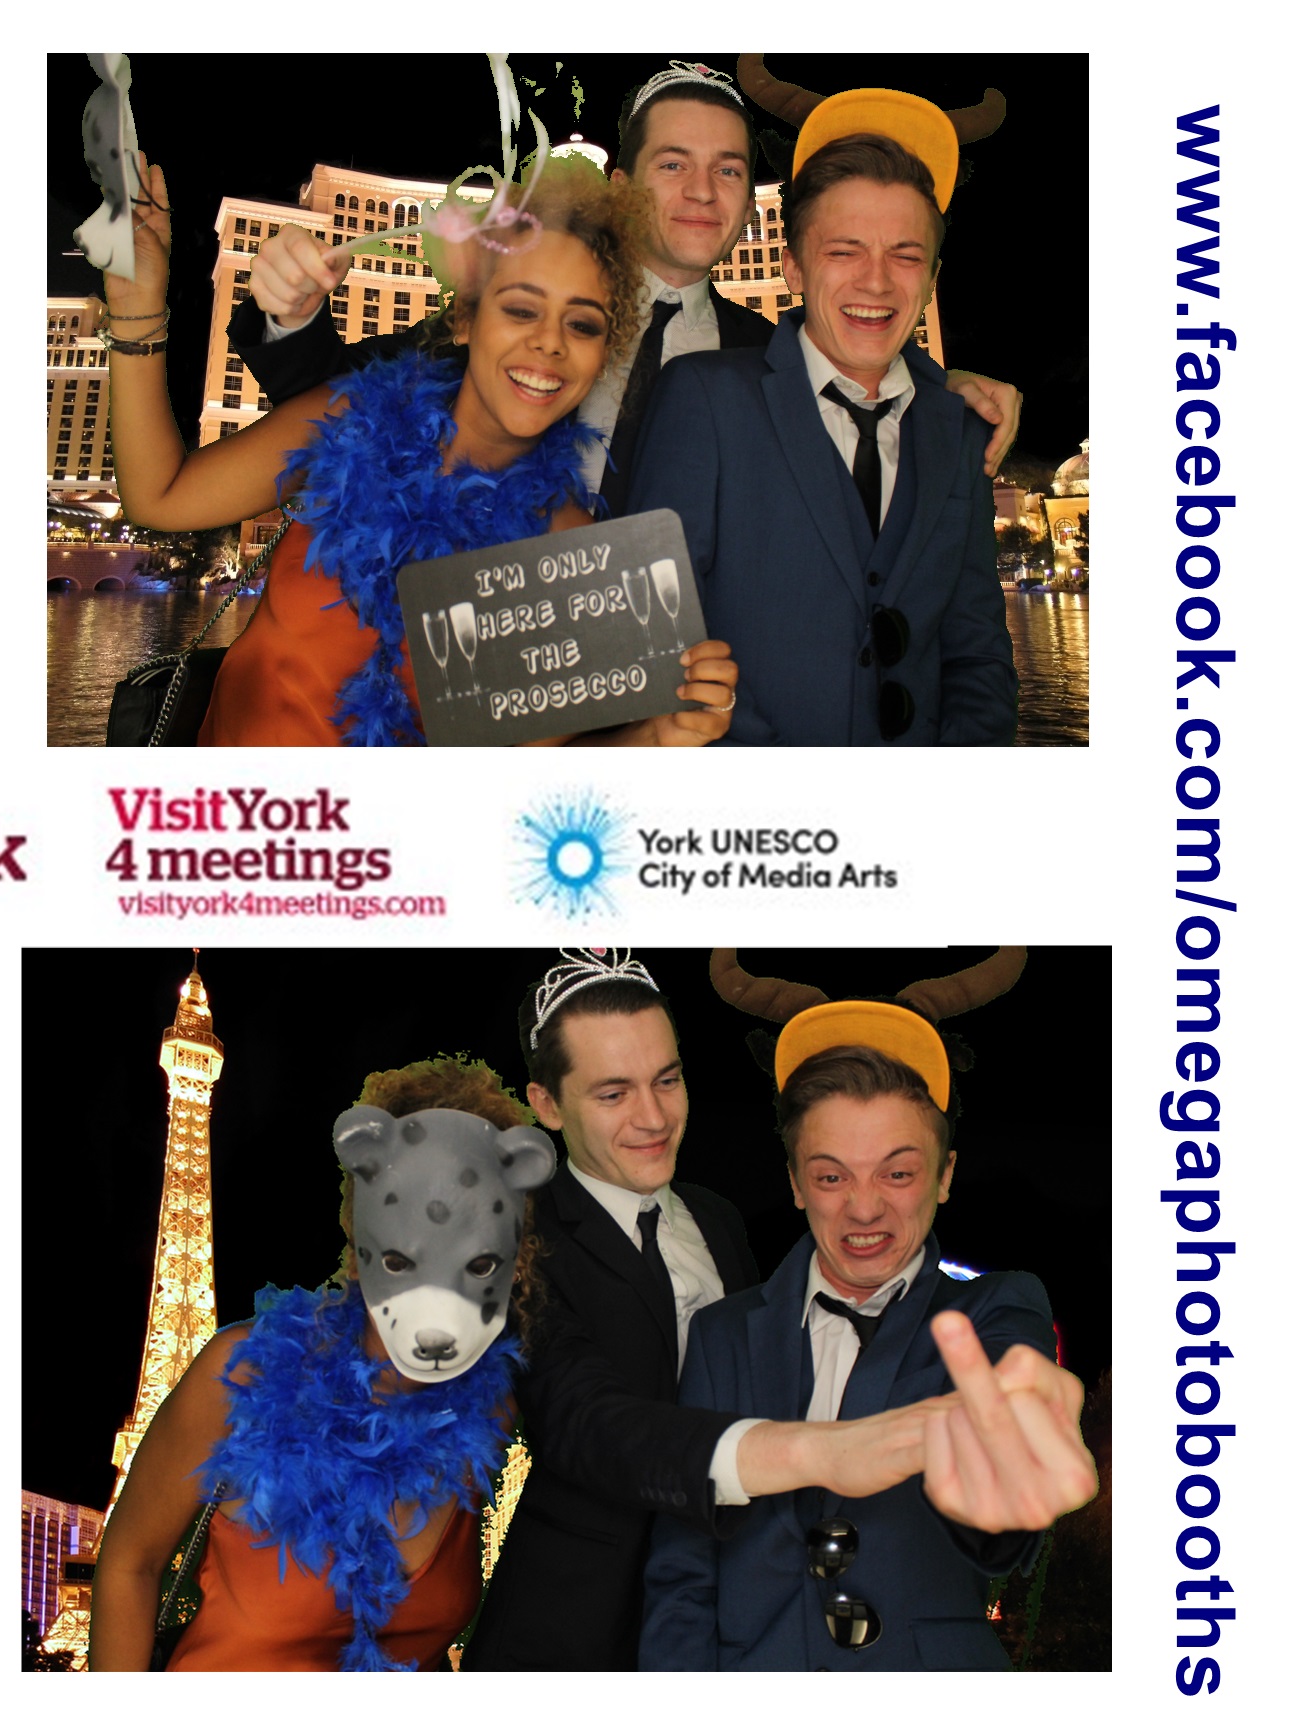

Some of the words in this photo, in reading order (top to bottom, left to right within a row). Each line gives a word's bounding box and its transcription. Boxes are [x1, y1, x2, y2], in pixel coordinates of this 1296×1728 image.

[475, 563, 526, 597] I'M
[538, 544, 611, 583] ONLY
[477, 600, 556, 641] HERE
[567, 585, 628, 622] FOR
[520, 639, 582, 675] THE
[490, 664, 647, 720] PROSECCO
